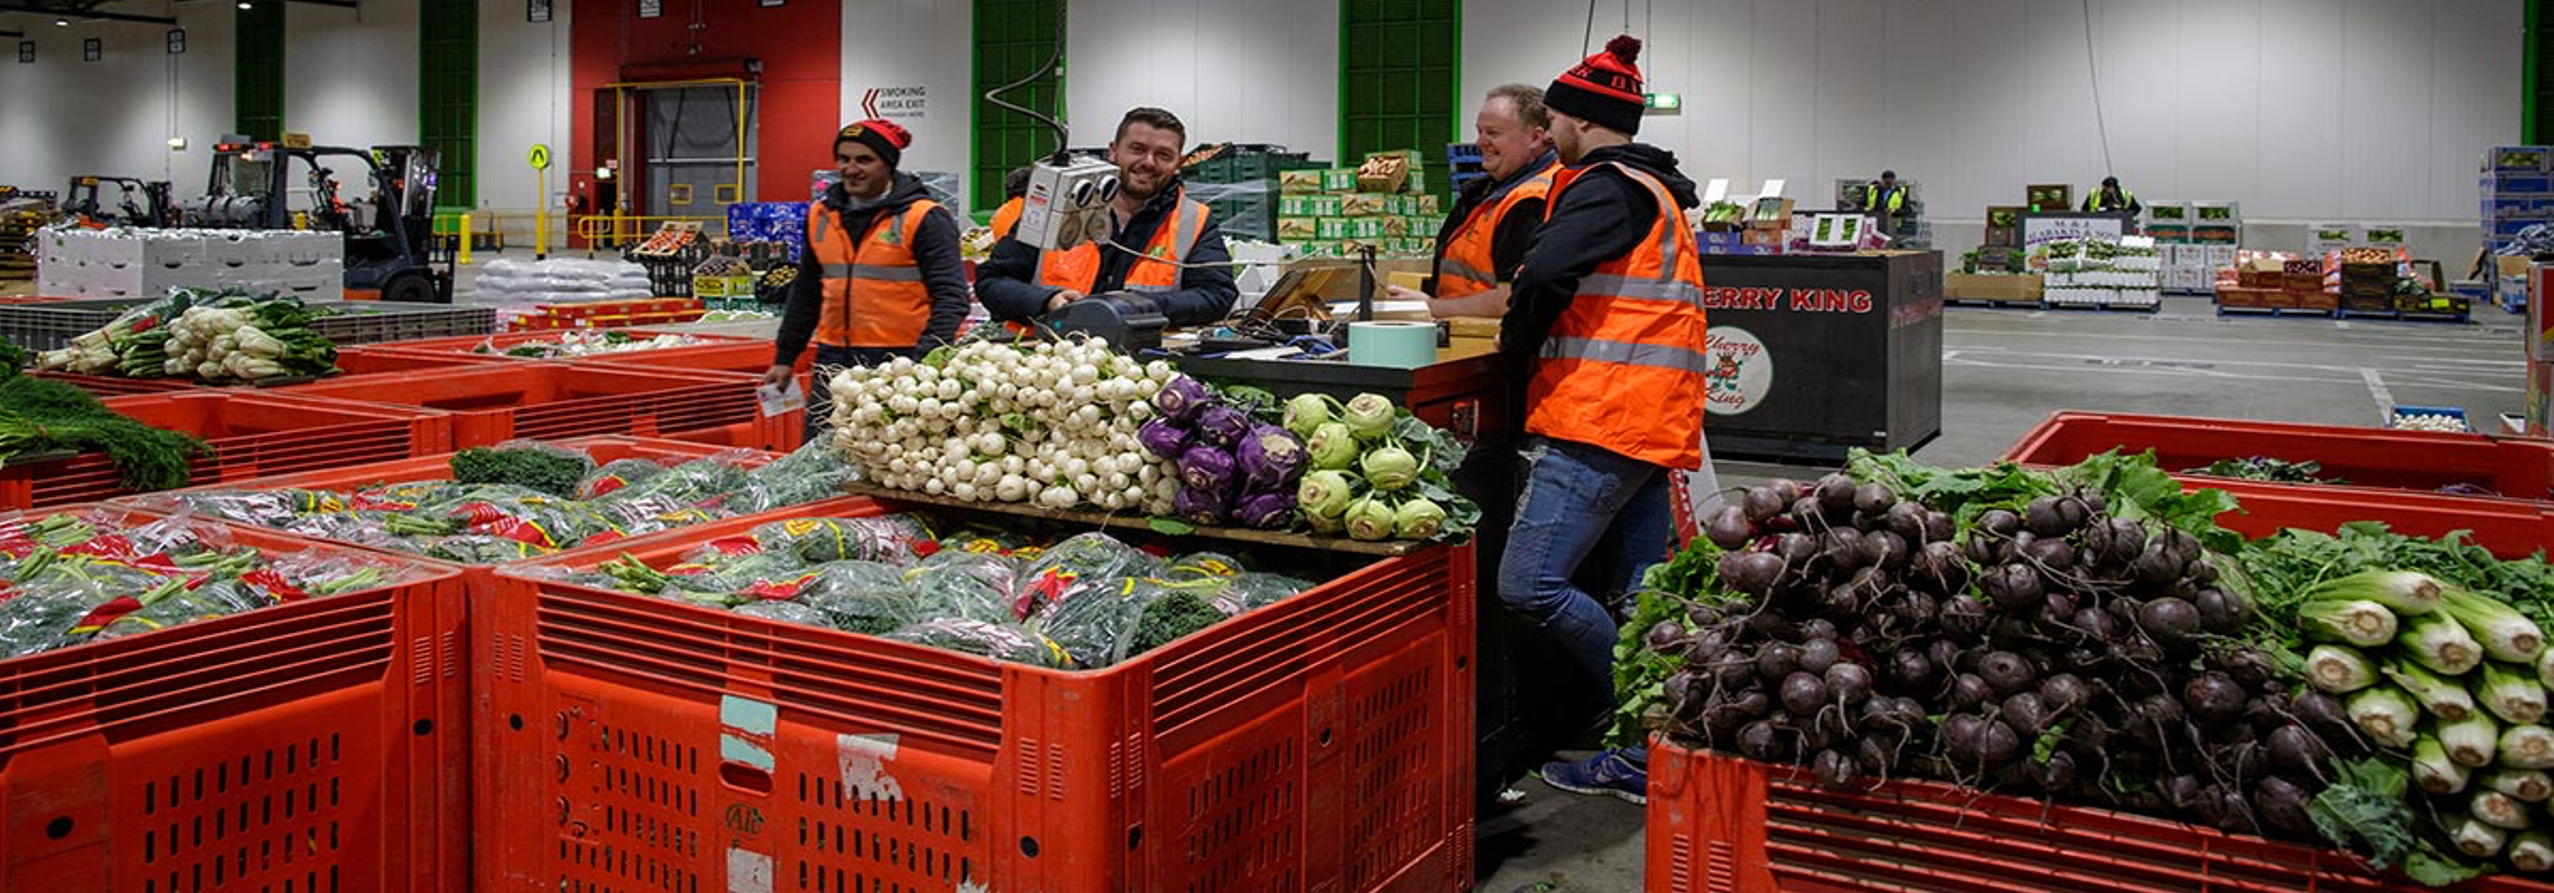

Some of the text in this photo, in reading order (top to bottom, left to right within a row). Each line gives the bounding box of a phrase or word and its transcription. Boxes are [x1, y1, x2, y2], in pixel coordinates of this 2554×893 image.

[880, 86, 926, 97] SMOKING
[880, 99, 925, 109] AREA EXIT
[1704, 286, 1872, 313] ERRY KING
